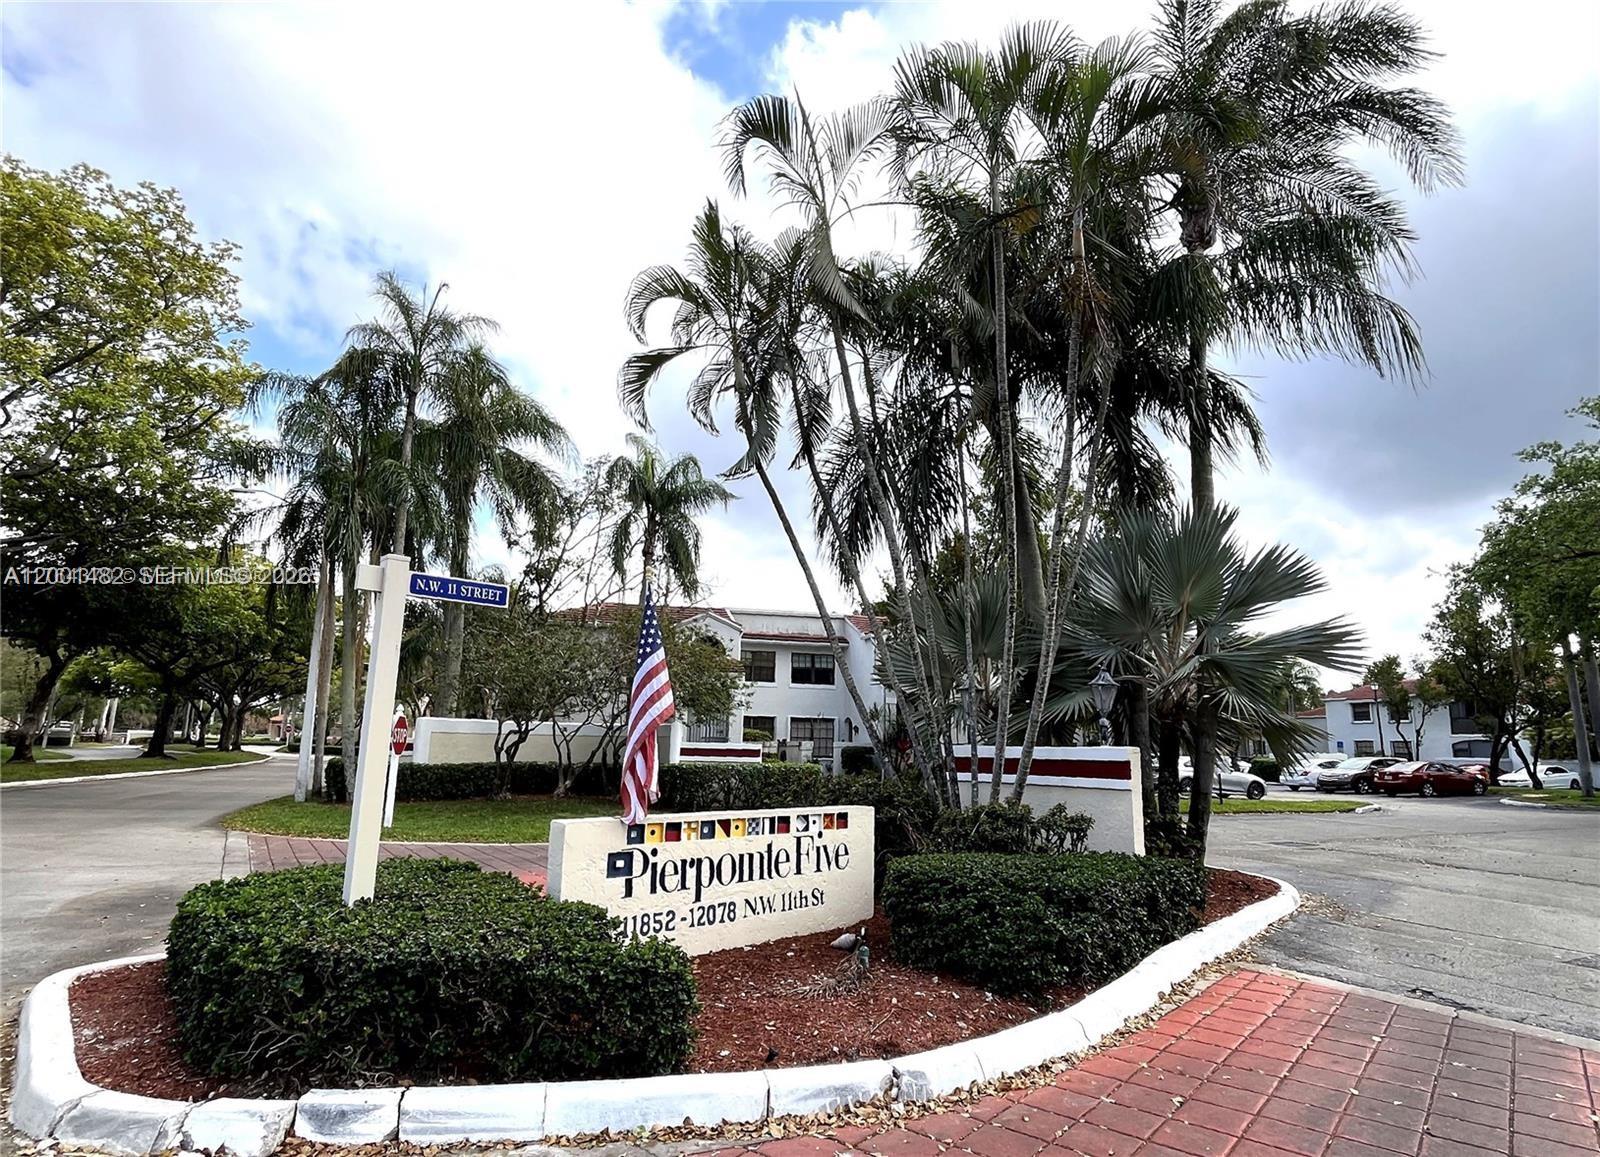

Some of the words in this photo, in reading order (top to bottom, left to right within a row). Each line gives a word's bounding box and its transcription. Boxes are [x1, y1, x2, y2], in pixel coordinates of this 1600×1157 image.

[416, 578, 444, 594] N.W.
[448, 583, 457, 595] 11
[460, 584, 503, 601] STREET
[394, 728, 407, 743] STOP
[793, 830, 849, 876] Five
[743, 893, 777, 919] N.W.
[781, 888, 809, 912] 11th
[811, 887, 826, 906] St
